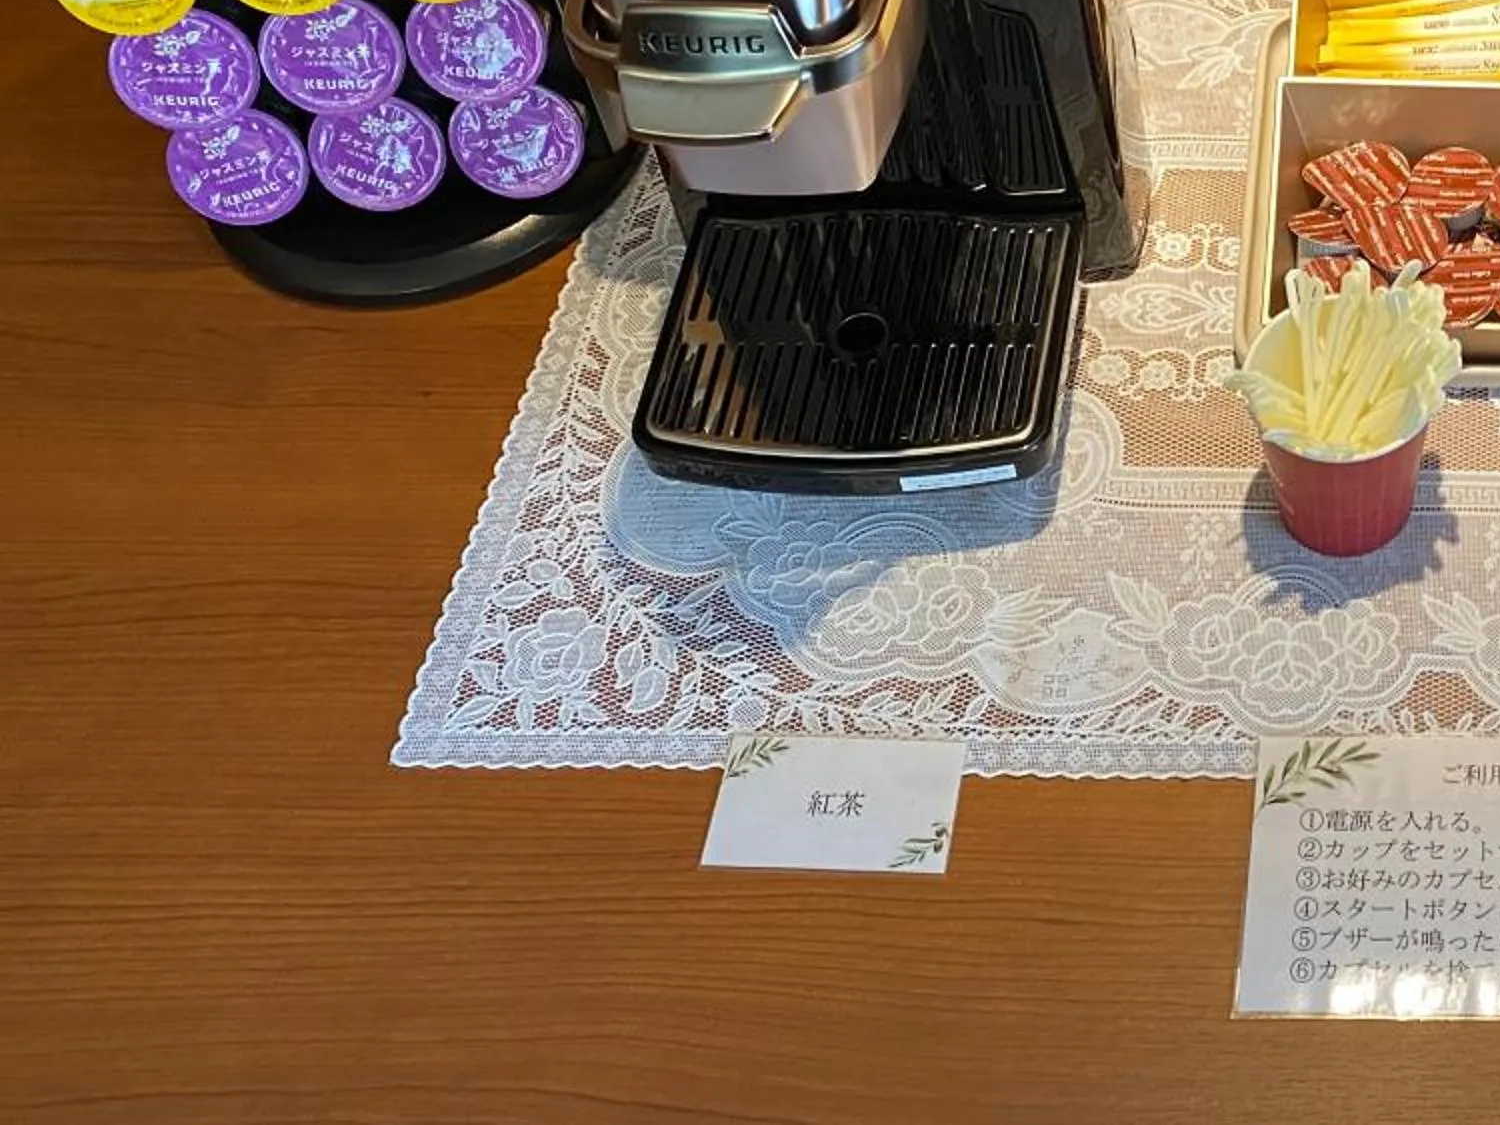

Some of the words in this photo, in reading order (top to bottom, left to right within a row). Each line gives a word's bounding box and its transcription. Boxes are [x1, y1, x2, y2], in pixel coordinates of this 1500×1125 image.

[640, 32, 766, 56] KEURIG
[304, 77, 377, 91] KEURIG
[153, 95, 220, 106] KEURIG
[334, 164, 398, 192] KEURIG
[221, 181, 281, 208] KEURIG
[807, 789, 866, 817] 紅茶
[1299, 809, 1485, 836] ①電源を入れる。
